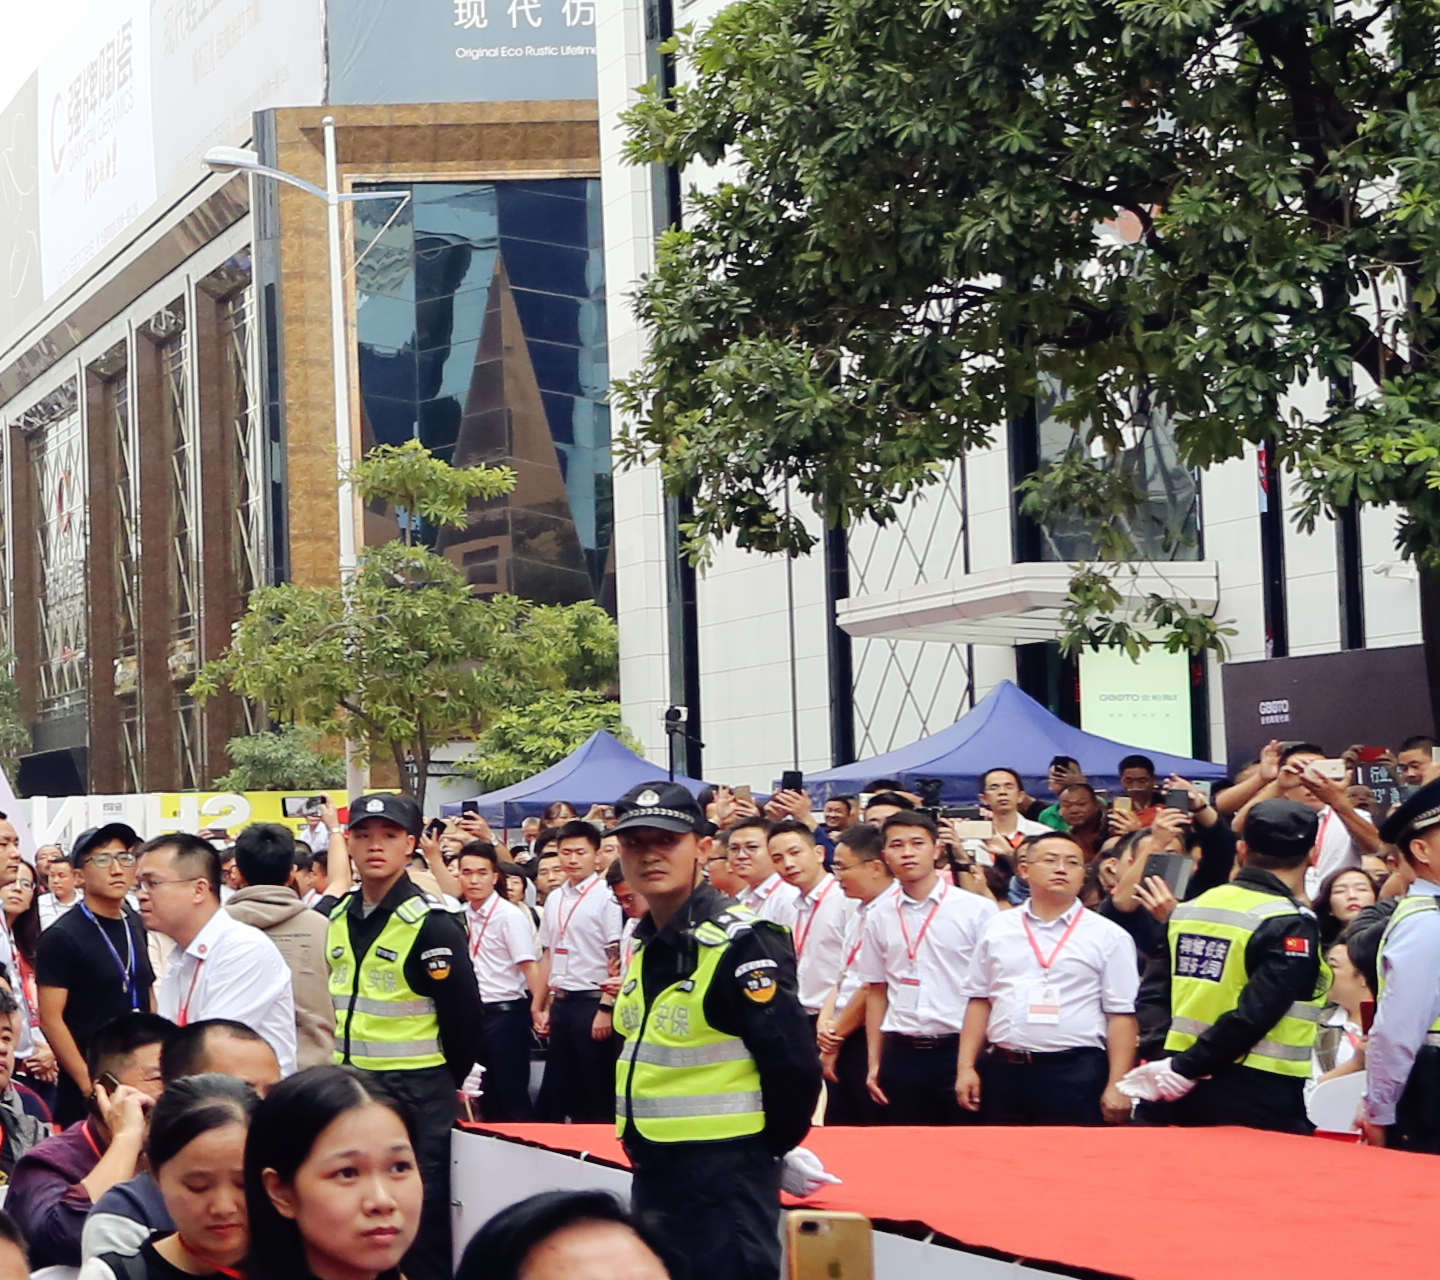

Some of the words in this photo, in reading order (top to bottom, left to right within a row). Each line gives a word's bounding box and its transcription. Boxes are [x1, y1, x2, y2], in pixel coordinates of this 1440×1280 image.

[455, 46, 499, 61] Original
[500, 46, 524, 57] Eco
[525, 45, 559, 57] Rustic
